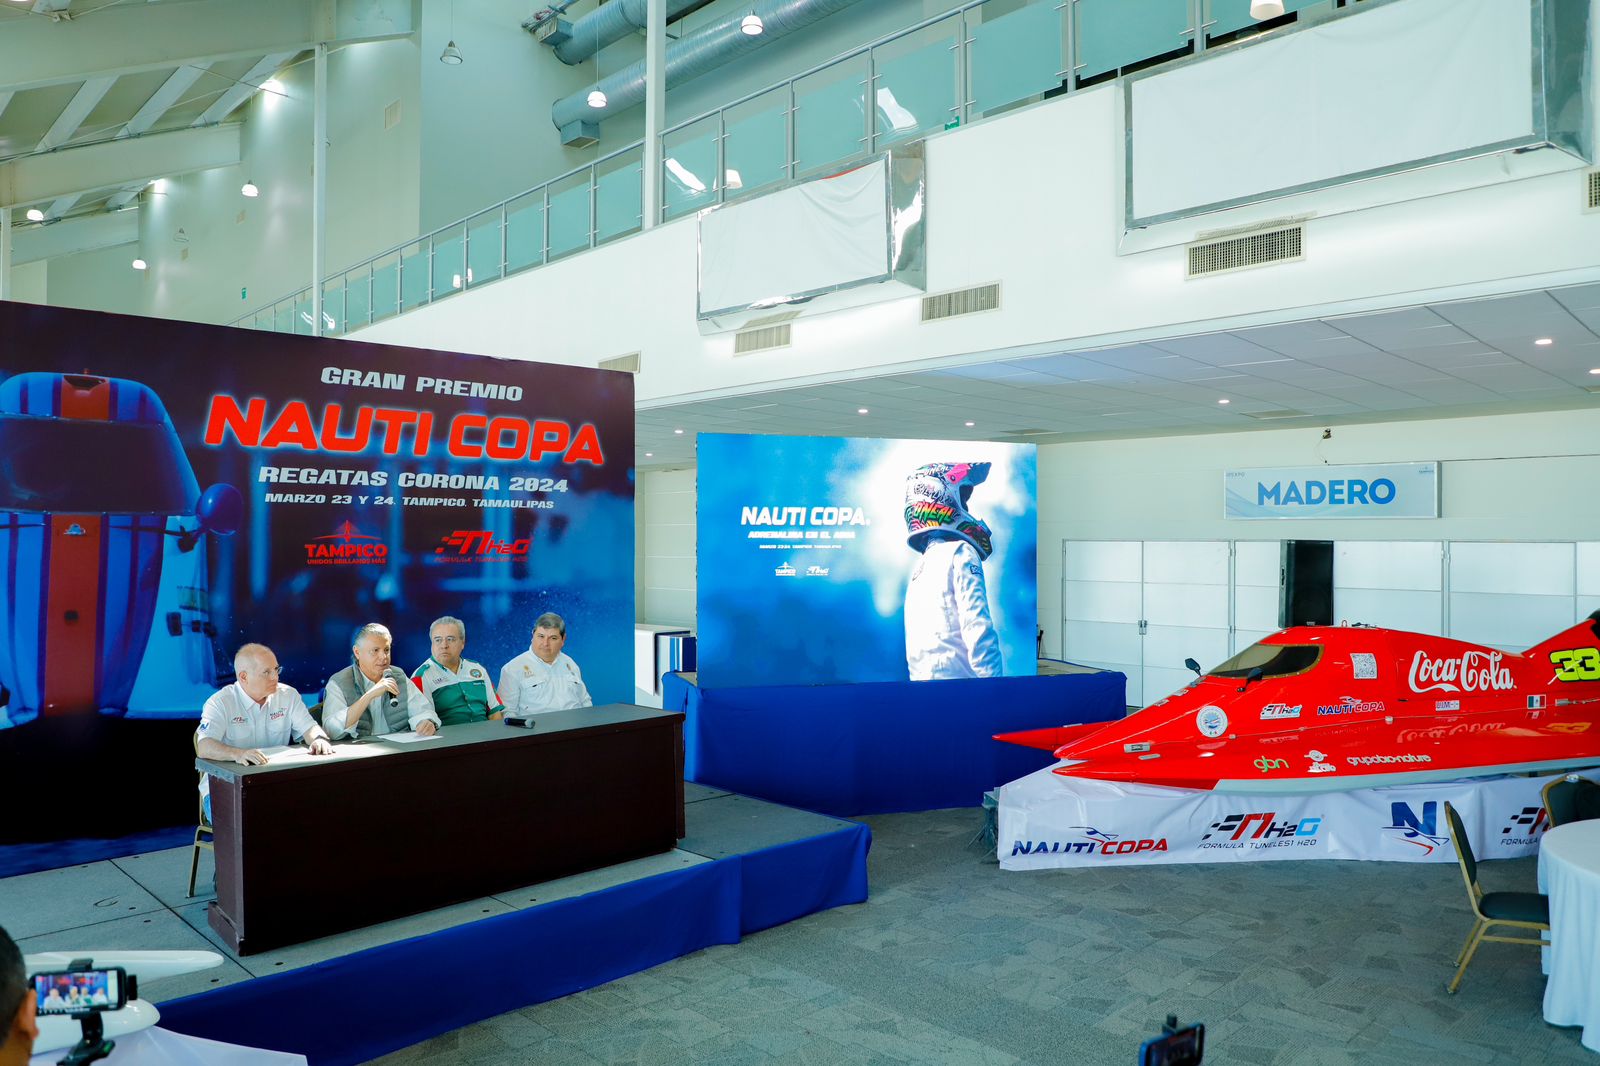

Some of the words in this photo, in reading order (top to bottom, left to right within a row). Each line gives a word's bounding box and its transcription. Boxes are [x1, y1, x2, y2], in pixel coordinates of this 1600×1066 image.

[320, 366, 406, 390] GRAN
[415, 376, 523, 402] PREMIO
[204, 394, 433, 457] NAUTI
[448, 413, 605, 465] COPA
[258, 466, 389, 487] REGATAS
[397, 472, 500, 491] CORONA
[508, 477, 569, 493] 2024
[264, 493, 327, 504] MARZO
[331, 494, 353, 505] 23
[358, 495, 370, 505] Y
[472, 498, 555, 509] TAMAULIPAS
[1257, 478, 1396, 506] MADERO
[741, 506, 807, 526] NAUTI
[304, 543, 388, 558] TAMPICO
[1408, 650, 1515, 693] Coca-Cola
[1549, 647, 1600, 682] 33
[1317, 705, 1354, 715] NAUTI
[1354, 702, 1386, 712] COPA
[1011, 840, 1096, 856] NAUTI
[1101, 838, 1168, 855] COPA
[1500, 837, 1539, 846] FORMULA
